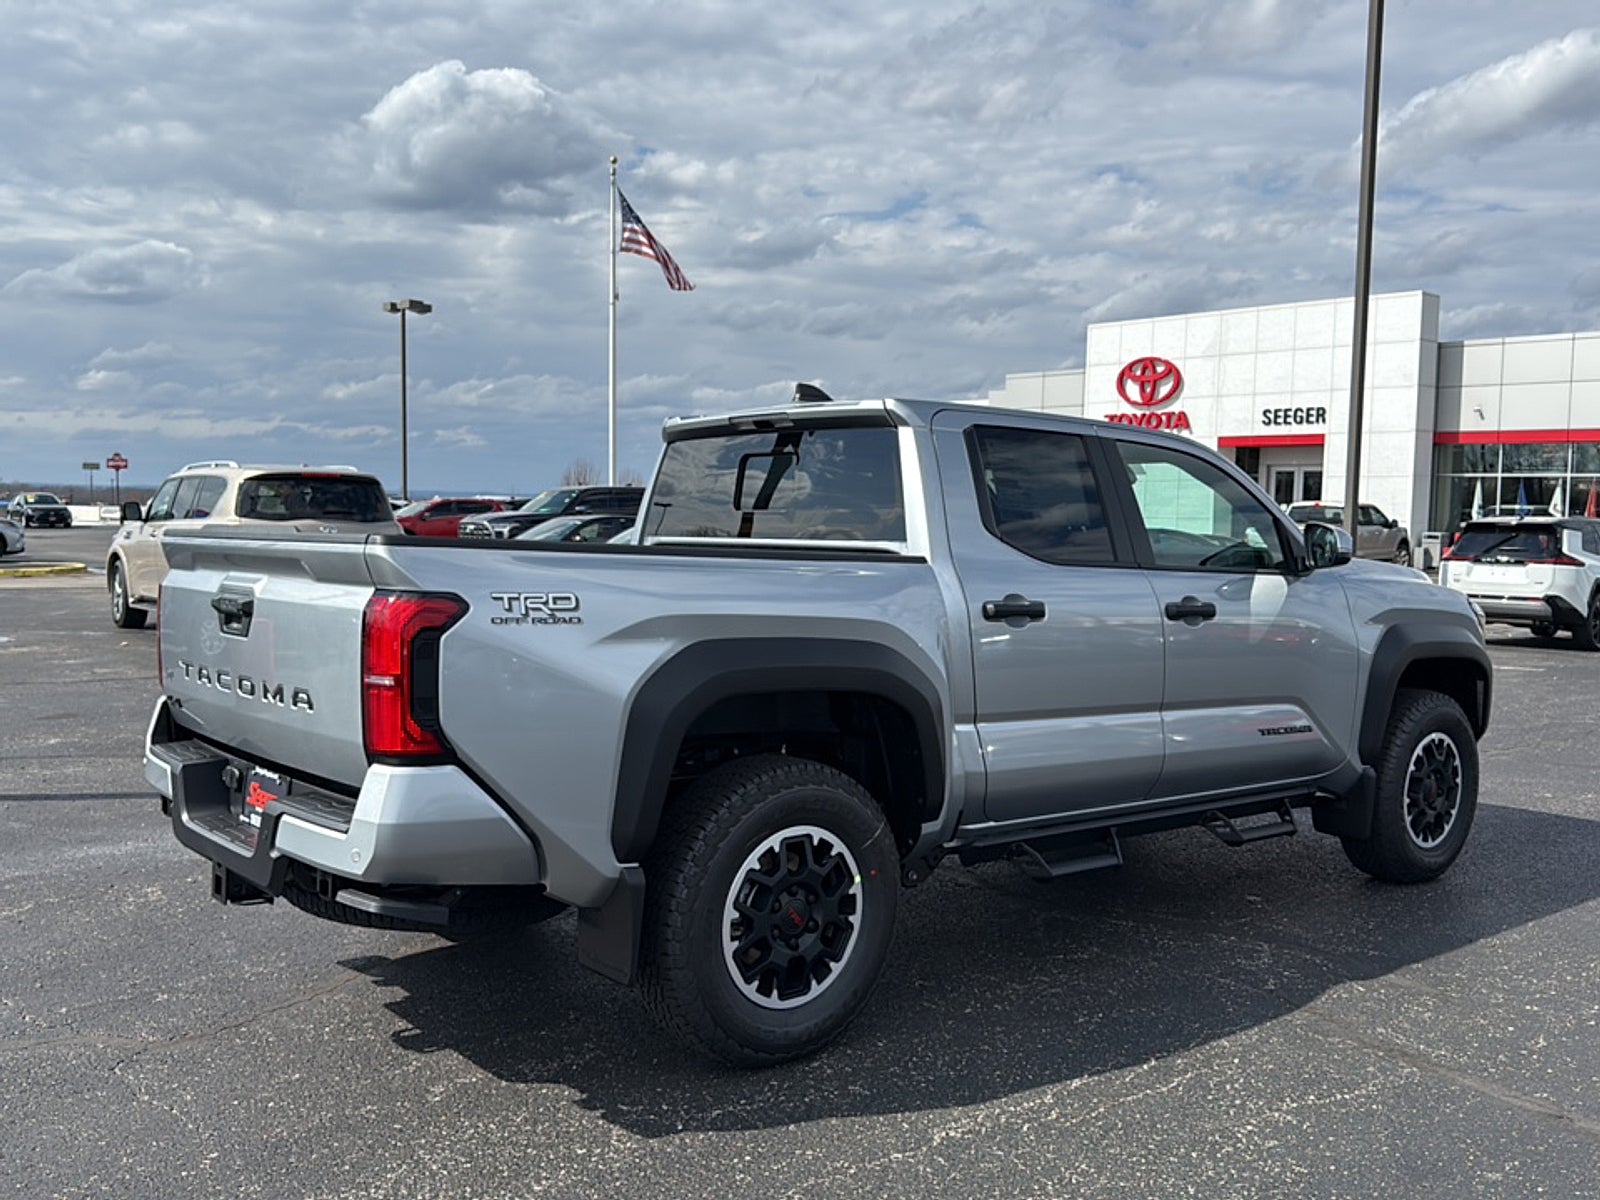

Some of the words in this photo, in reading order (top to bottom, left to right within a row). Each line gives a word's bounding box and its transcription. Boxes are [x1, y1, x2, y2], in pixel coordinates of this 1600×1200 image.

[1261, 406, 1327, 426] SEEGER
[490, 591, 580, 617] TRD
[490, 616, 530, 625] OFF
[531, 616, 583, 625] ROAD
[178, 659, 315, 714] TACOMA
